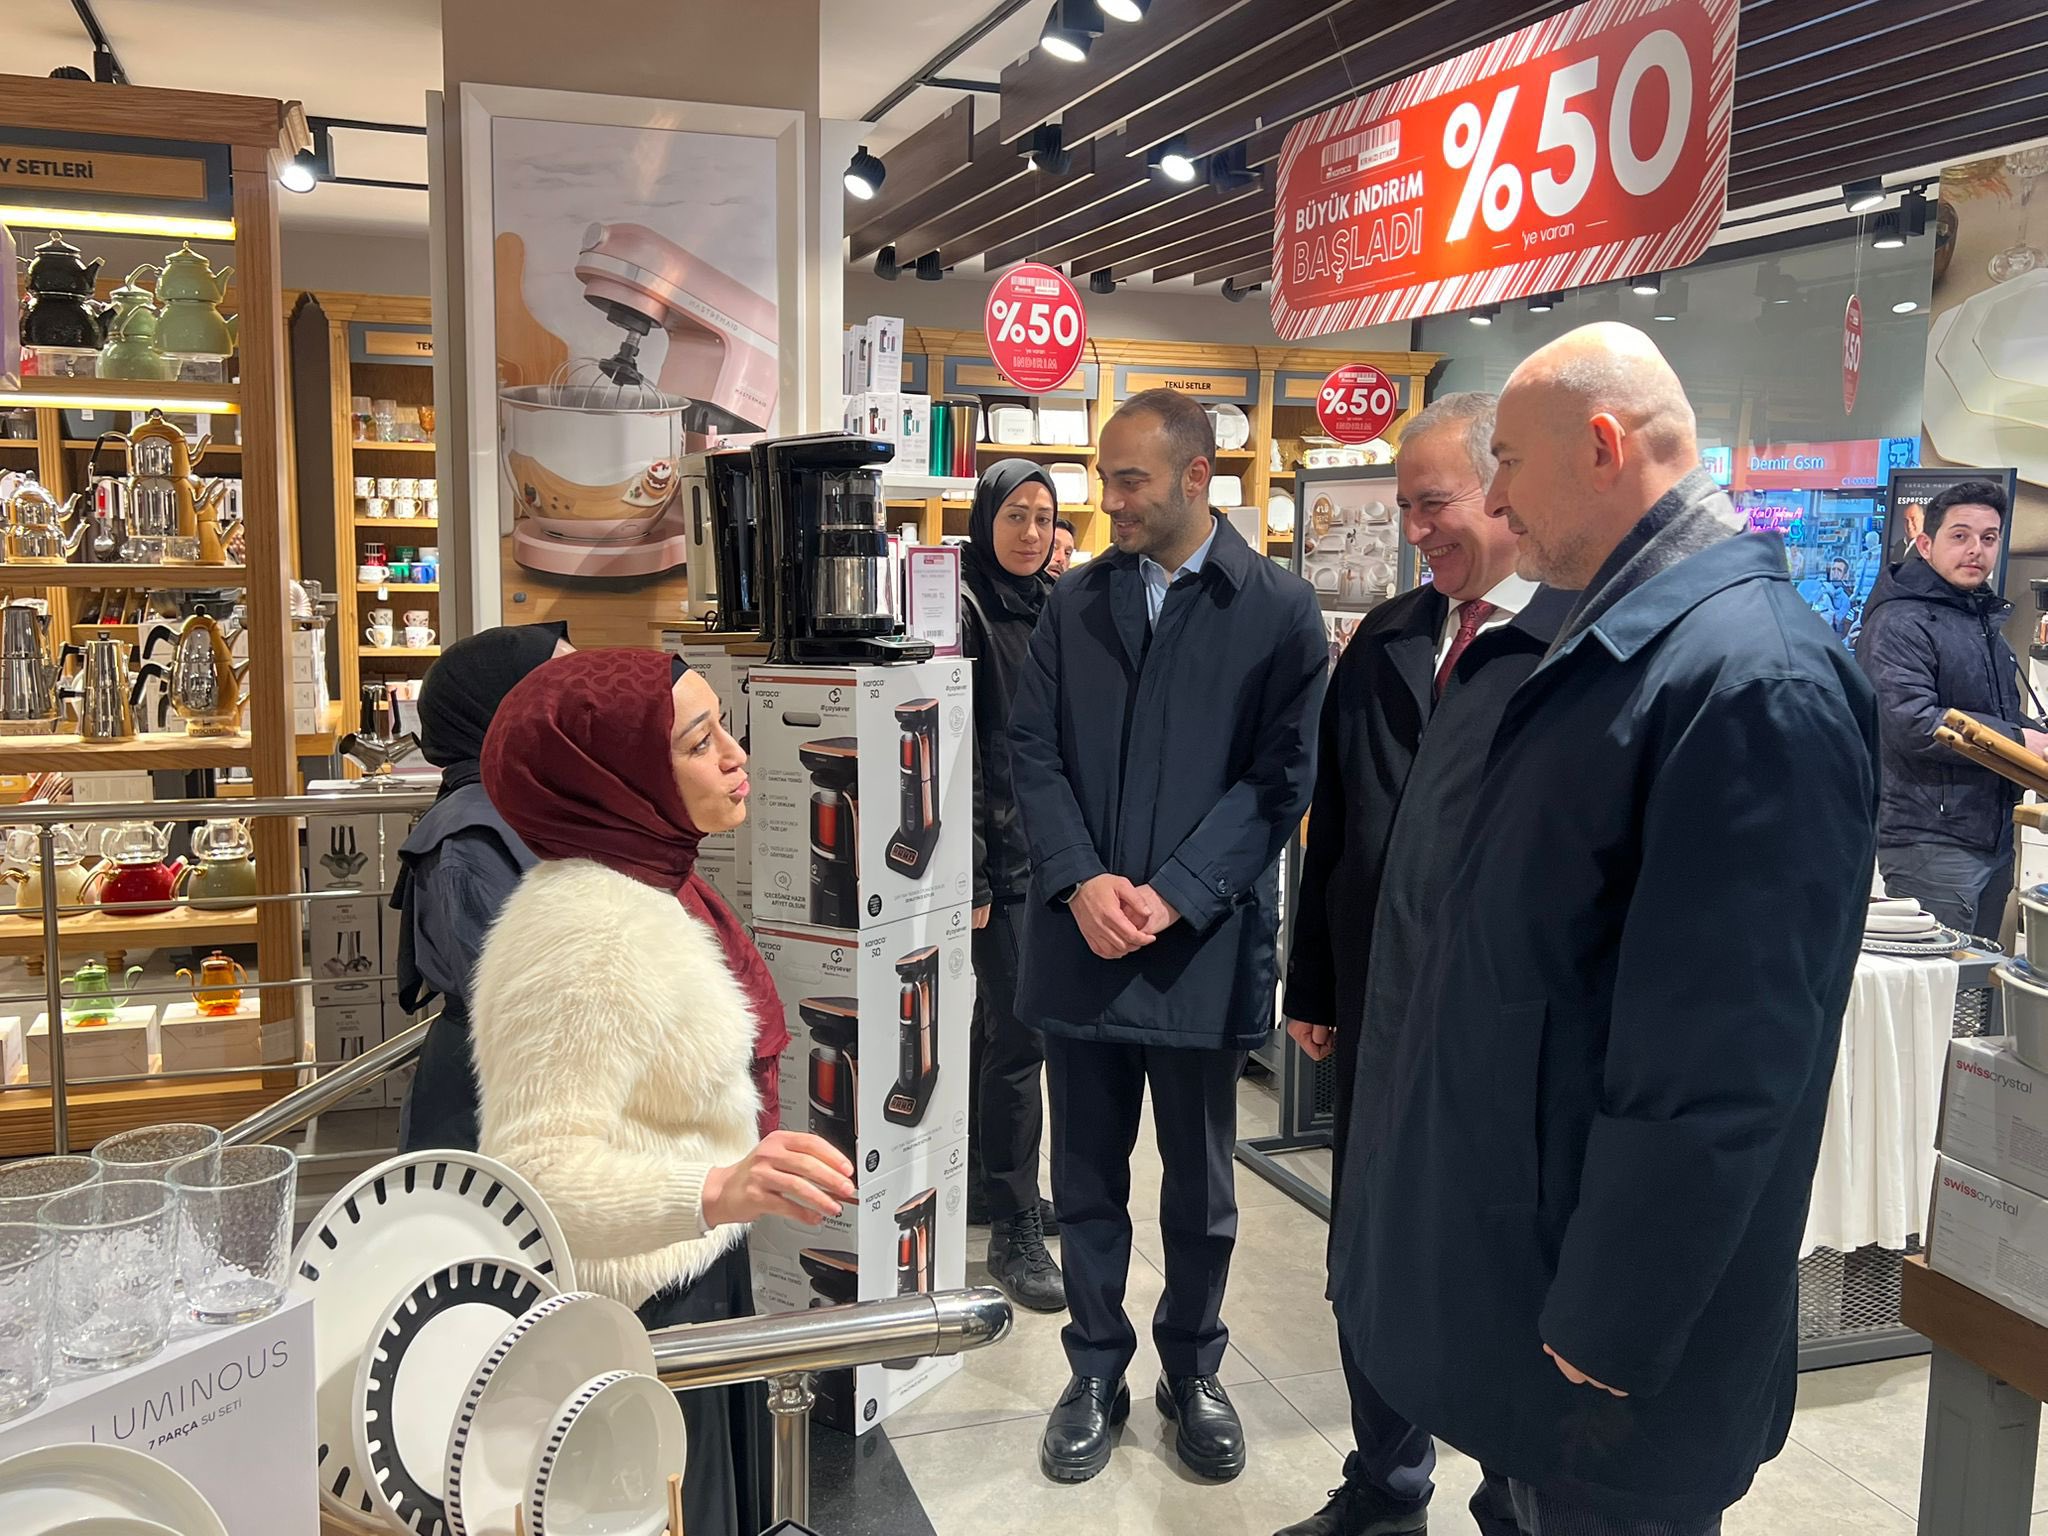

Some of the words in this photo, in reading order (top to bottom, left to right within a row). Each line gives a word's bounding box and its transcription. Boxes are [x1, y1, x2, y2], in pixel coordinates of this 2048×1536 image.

[1442, 29, 1693, 243] %50
[16, 159, 94, 178] SETLERİ
[1295, 192, 1351, 233] BÜYÜK
[1540, 222, 1575, 241] varan
[1292, 207, 1423, 284] BAŞLADI
[991, 299, 1079, 347] %50
[1164, 380, 1185, 389] TEKLİ
[1185, 381, 1211, 390] SETLER
[1321, 387, 1391, 416] %50
[1750, 456, 1790, 471] Demir
[1793, 455, 1825, 471] Gsm
[863, 679, 884, 688] karaca
[755, 690, 780, 698] karaca
[757, 941, 782, 952] karaca
[864, 936, 887, 948] karaca
[1956, 1060, 2033, 1094] swisscrystal
[865, 1188, 887, 1203] karaca
[1943, 1177, 2019, 1217] swisscrystal
[147, 1439, 156, 1450] 7
[158, 1420, 199, 1446] PARÇA
[201, 1411, 216, 1426] SU
[218, 1397, 242, 1418] SETİ
